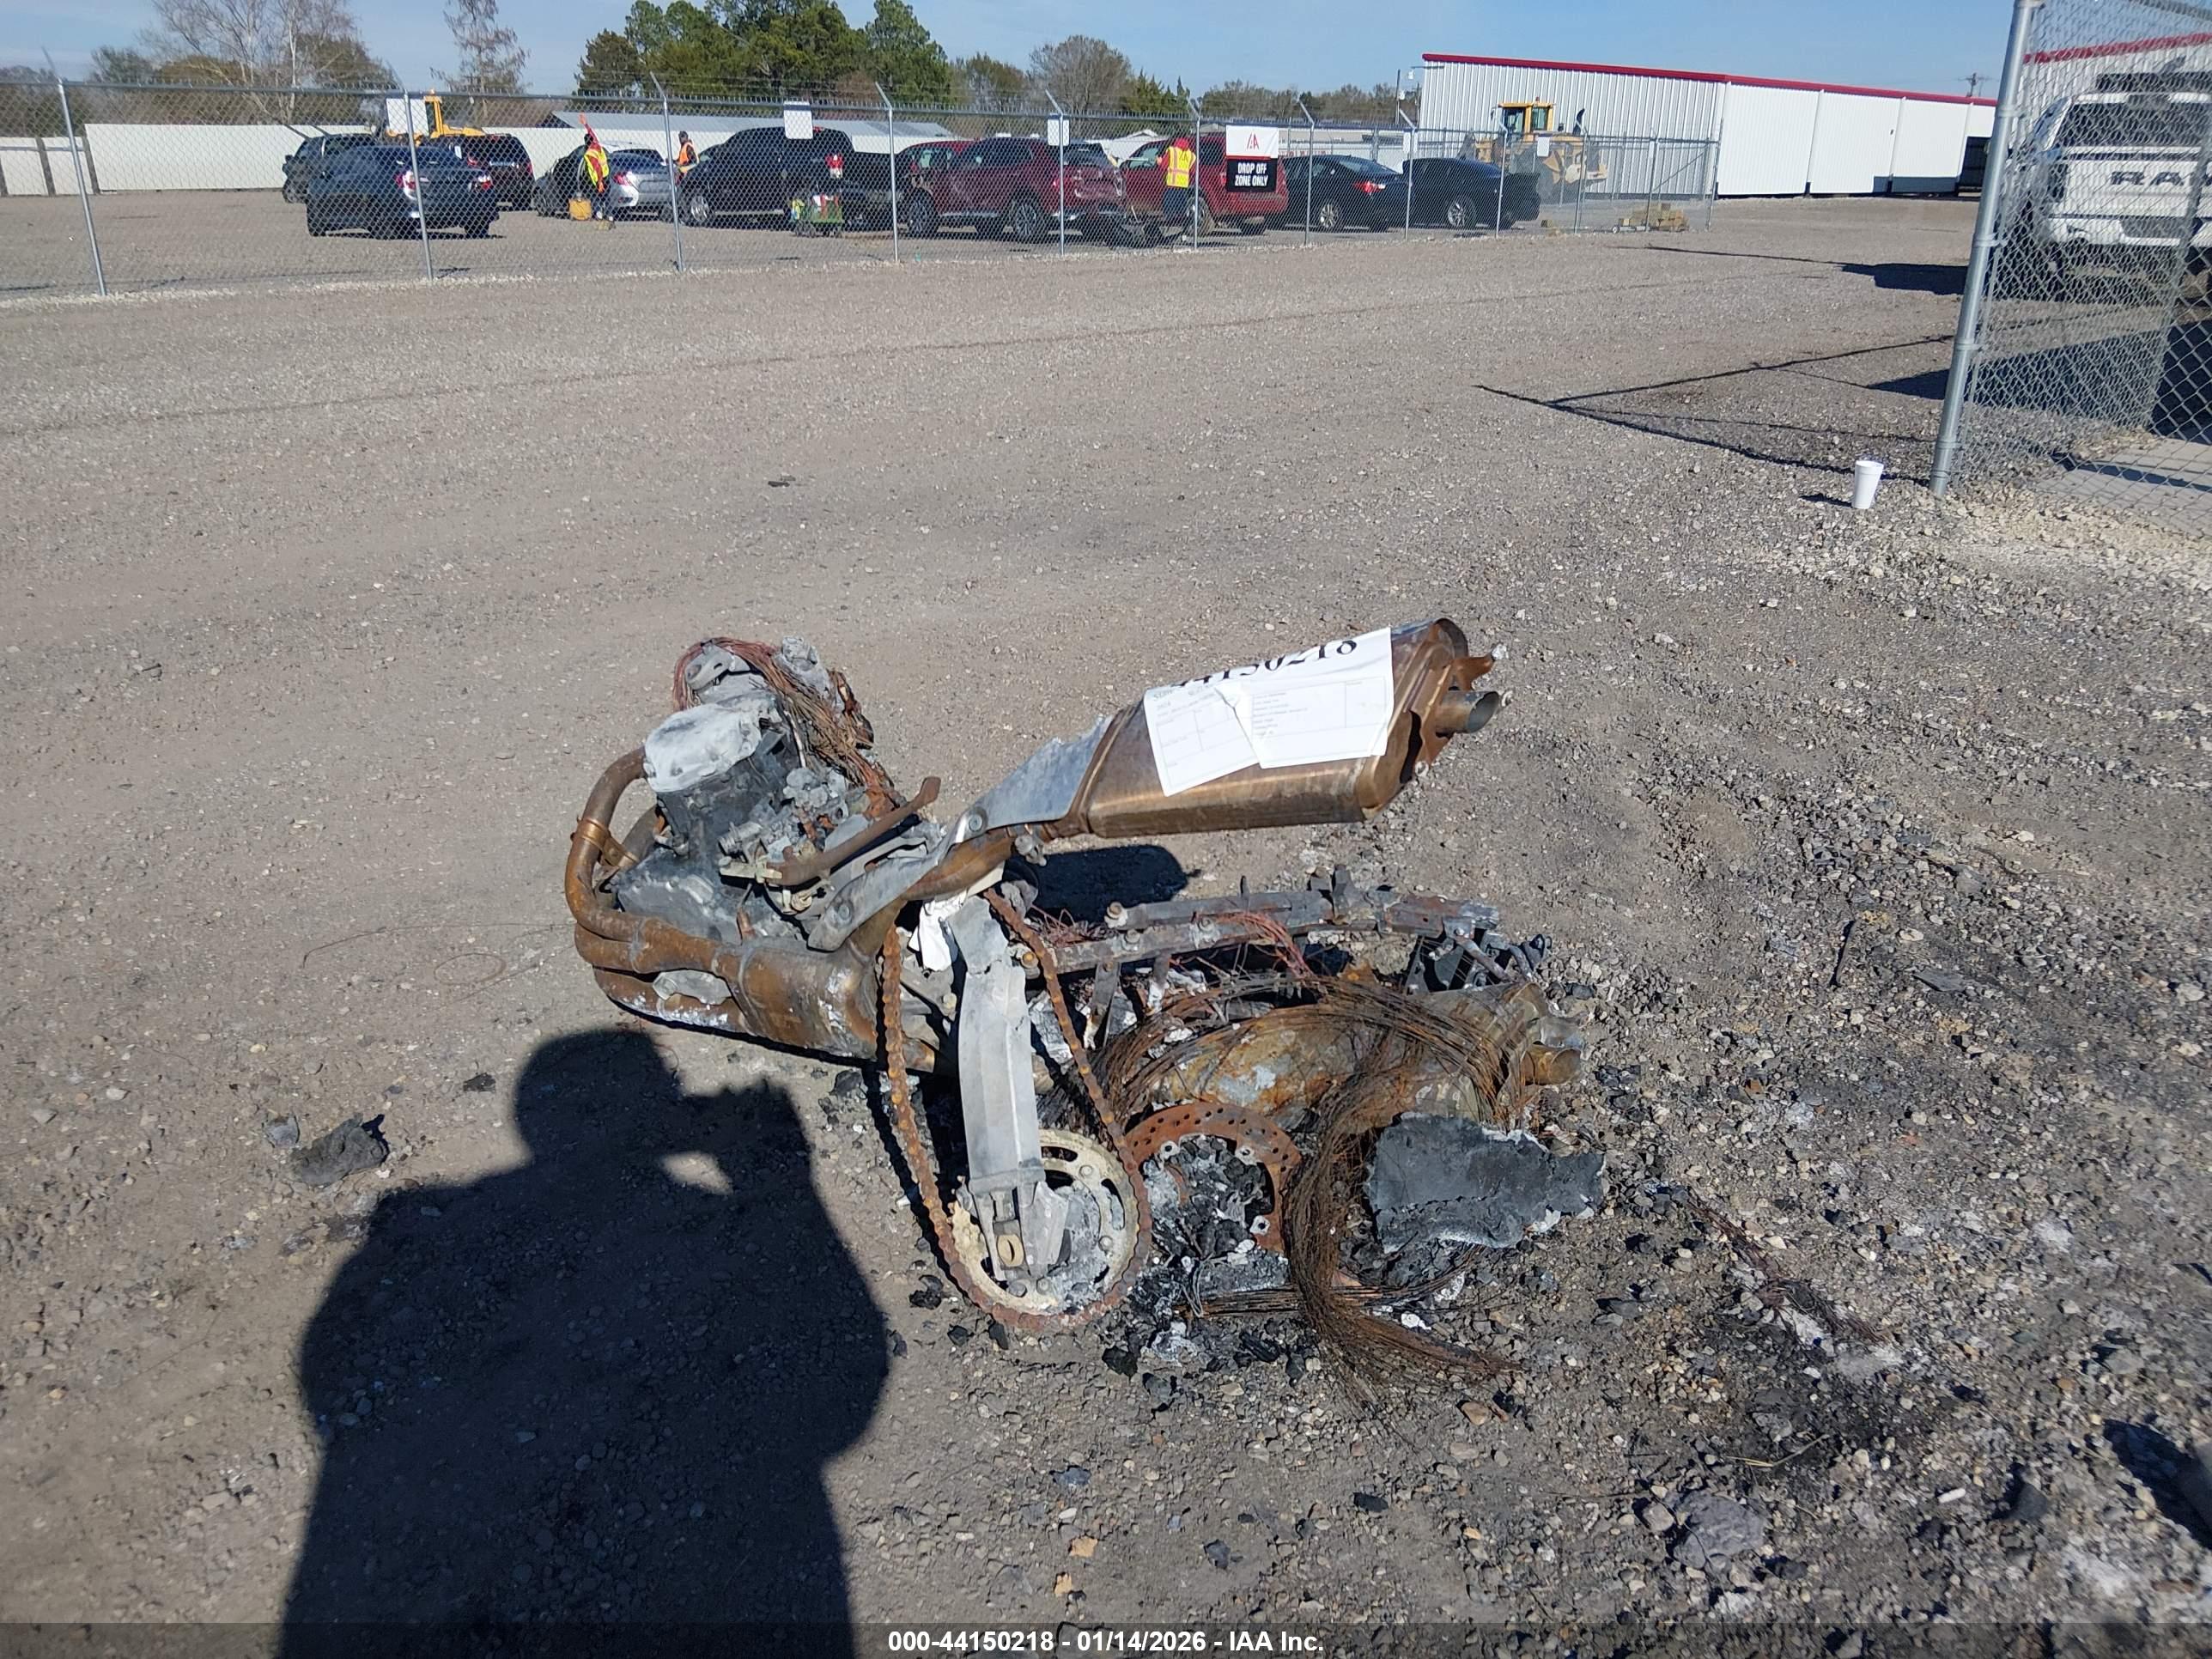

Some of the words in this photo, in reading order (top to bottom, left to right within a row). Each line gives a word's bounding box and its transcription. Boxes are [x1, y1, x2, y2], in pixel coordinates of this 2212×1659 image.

[1238, 162, 1255, 174] DROP
[1256, 163, 1267, 174] OFF
[1235, 175, 1251, 186] ZONE
[1252, 175, 1268, 186] ONLY
[2111, 172, 2212, 186] RA
